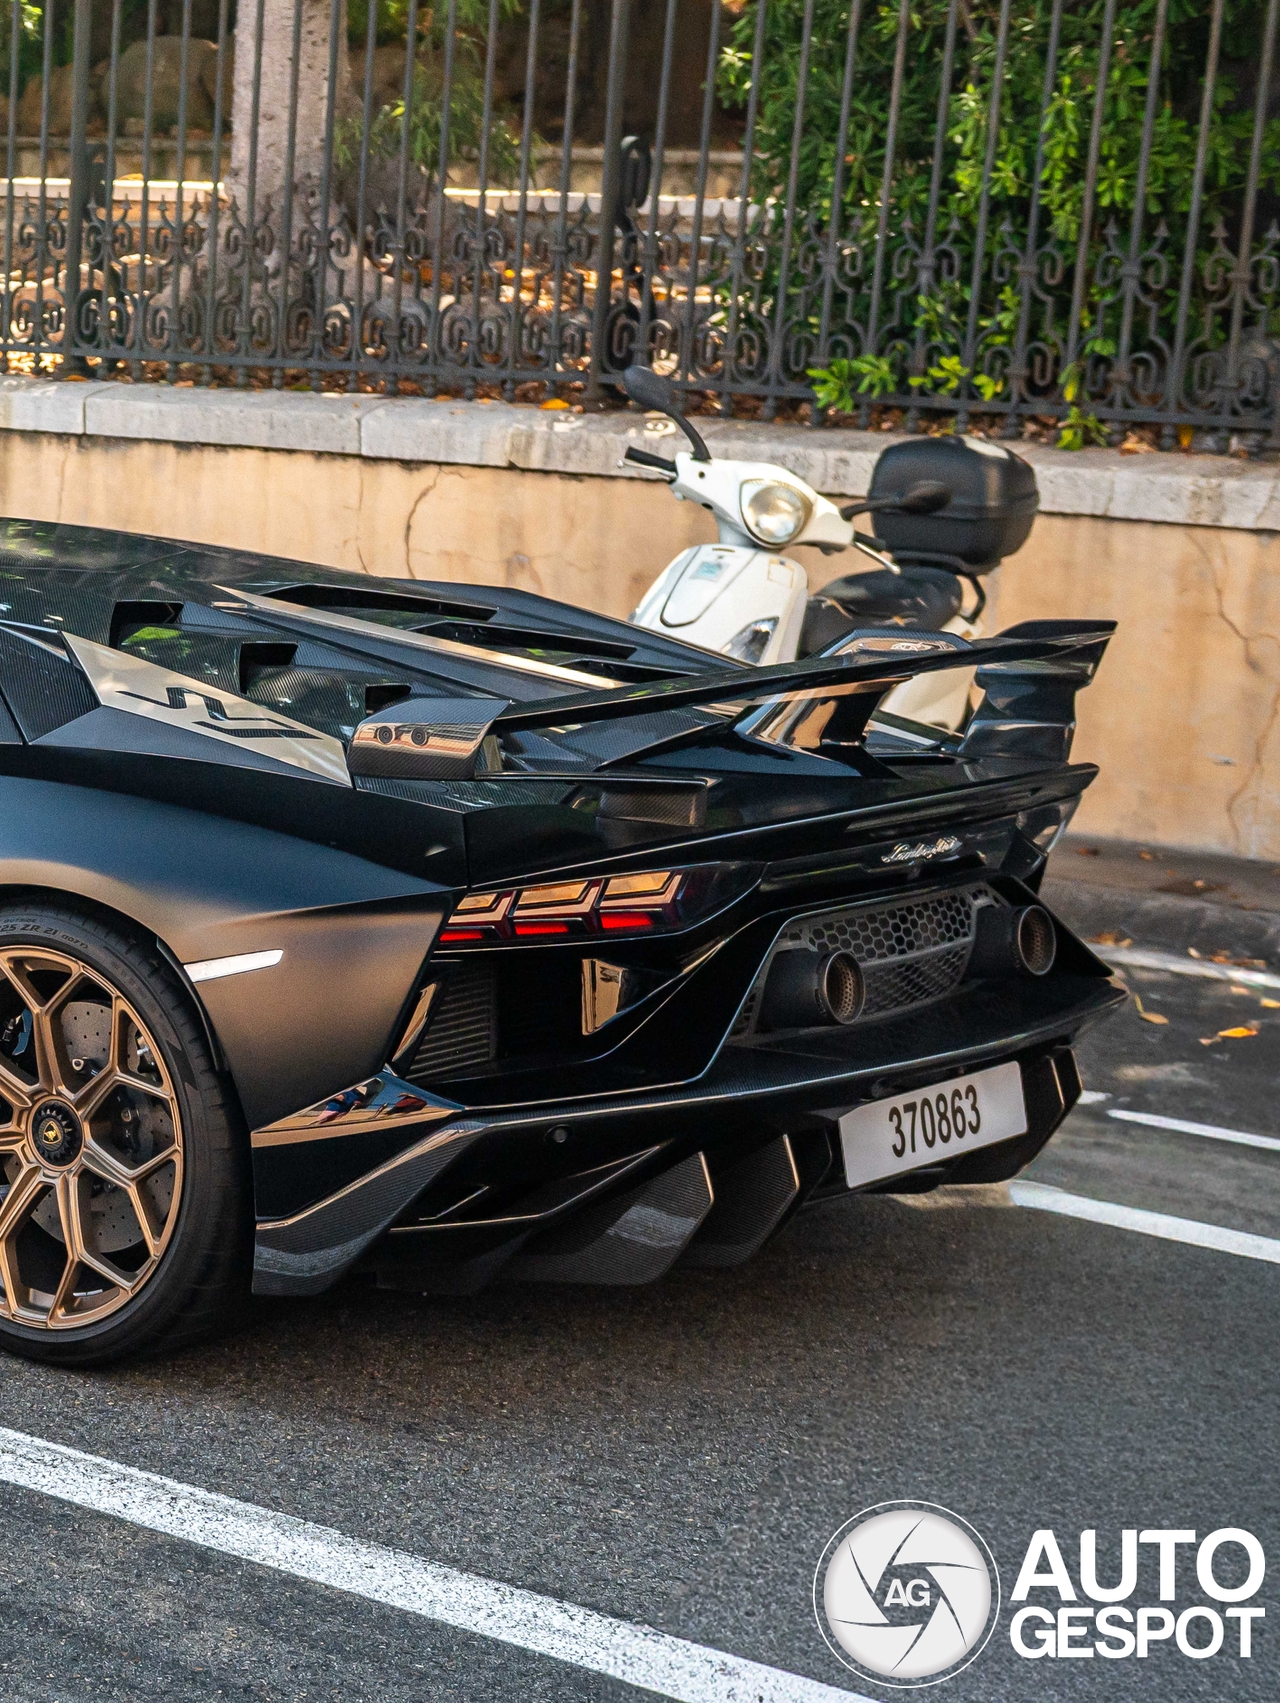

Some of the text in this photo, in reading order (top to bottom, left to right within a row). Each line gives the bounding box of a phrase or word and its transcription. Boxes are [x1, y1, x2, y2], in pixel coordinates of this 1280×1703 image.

[20, 924, 41, 932] ZR
[43, 927, 58, 936] 21
[888, 1084, 981, 1158] 370863
